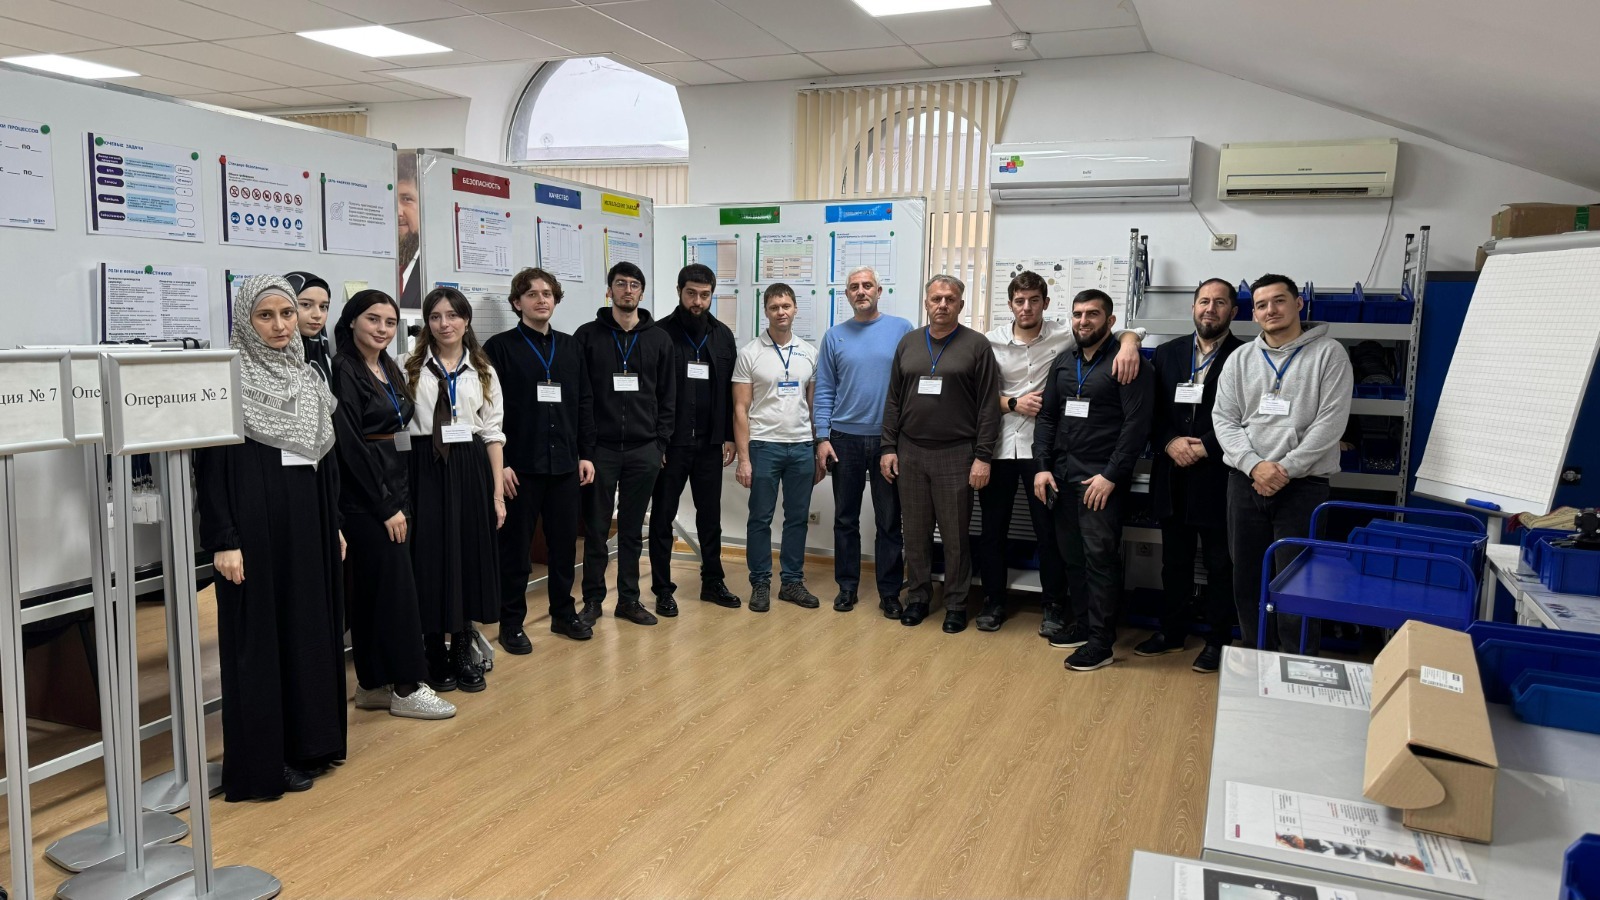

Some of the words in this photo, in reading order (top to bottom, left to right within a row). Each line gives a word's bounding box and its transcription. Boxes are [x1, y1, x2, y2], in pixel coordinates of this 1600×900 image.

[462, 177, 501, 190] БЕЗОПАСНОСТЬ
[548, 191, 571, 202] КАЧЕСТВО
[28, 389, 45, 402] №
[49, 388, 57, 401] 7
[124, 392, 197, 409] Операция
[200, 388, 217, 402] №
[219, 387, 229, 400] 2
[265, 395, 283, 409] DIOR
